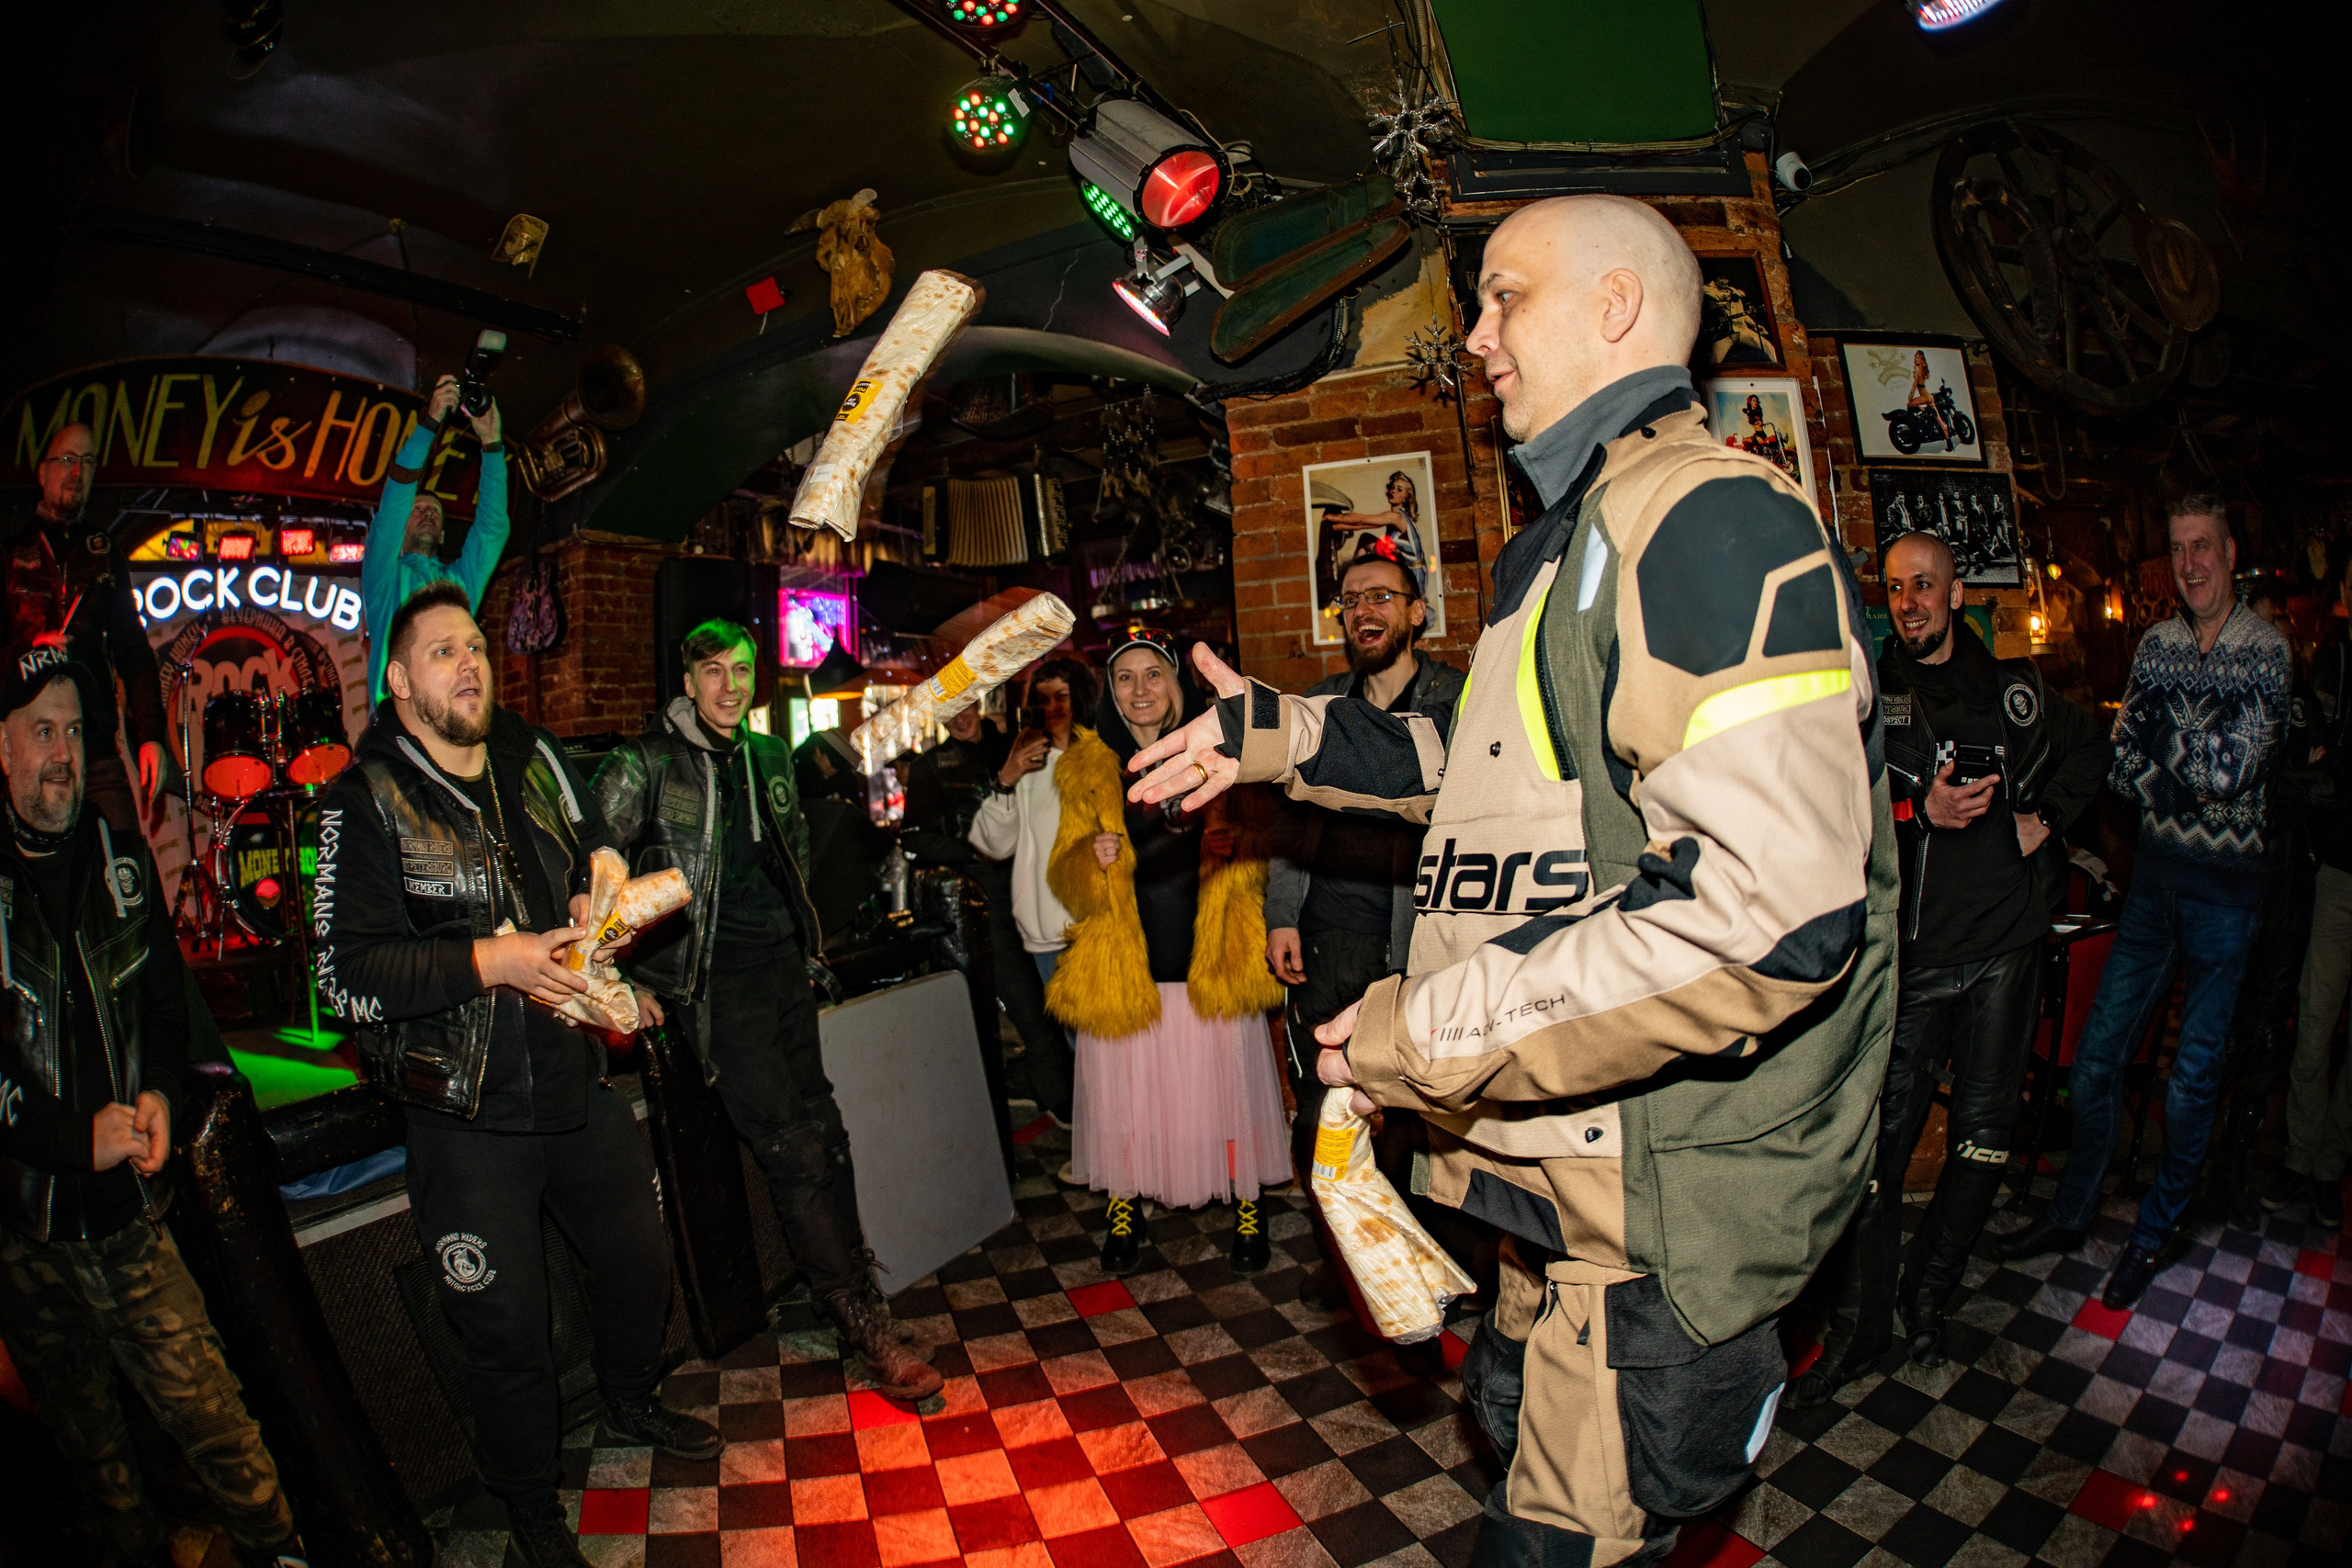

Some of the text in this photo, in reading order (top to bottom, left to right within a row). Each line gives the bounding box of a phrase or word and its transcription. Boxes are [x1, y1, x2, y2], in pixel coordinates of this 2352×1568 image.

[16, 373, 514, 505] MONEY is HOE
[247, 566, 362, 631] CLUB
[409, 881, 446, 895] MEMBER
[1414, 838, 1589, 910] stars
[313, 809, 344, 937] NORMANS
[351, 996, 385, 1023] MC
[1957, 1139, 2010, 1165] ico
